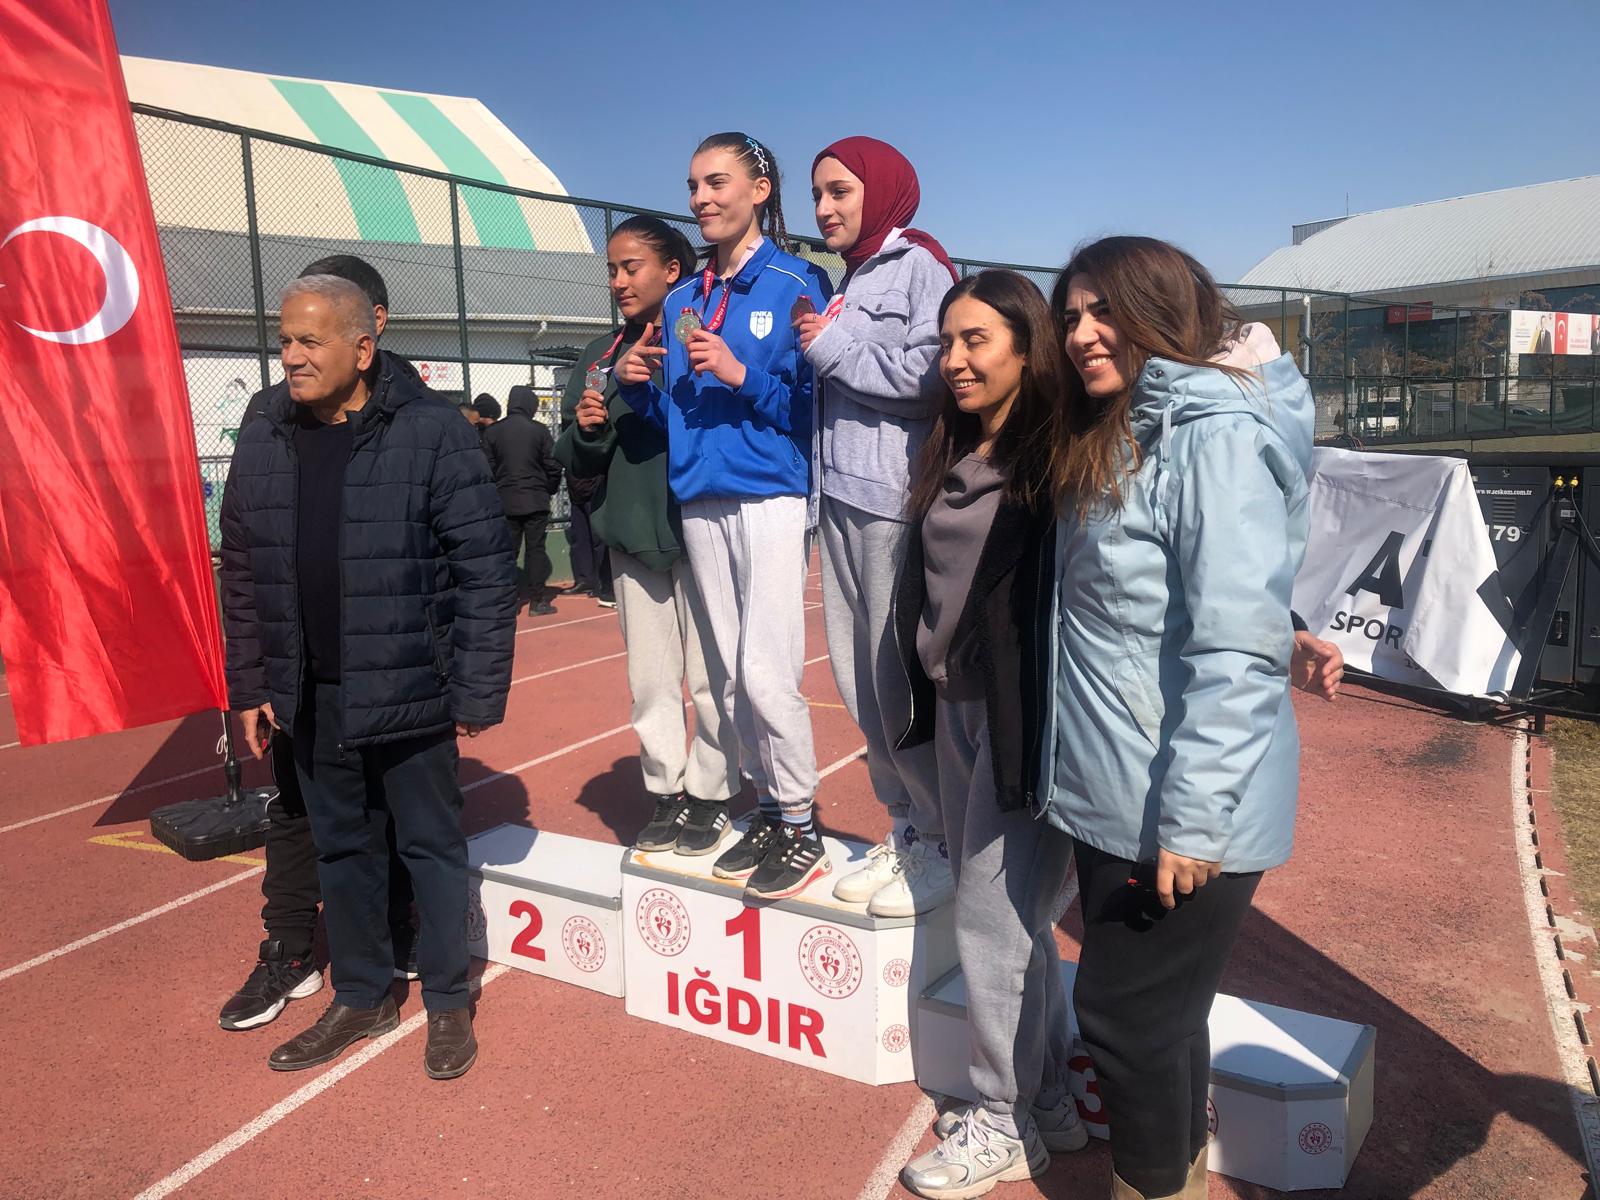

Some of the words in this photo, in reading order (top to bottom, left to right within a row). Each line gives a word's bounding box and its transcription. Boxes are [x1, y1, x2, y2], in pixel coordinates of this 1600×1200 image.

[1329, 610, 1404, 650] SPOR
[508, 900, 546, 962] 2
[725, 906, 762, 981] 1
[667, 966, 827, 1059] IĞDIR
